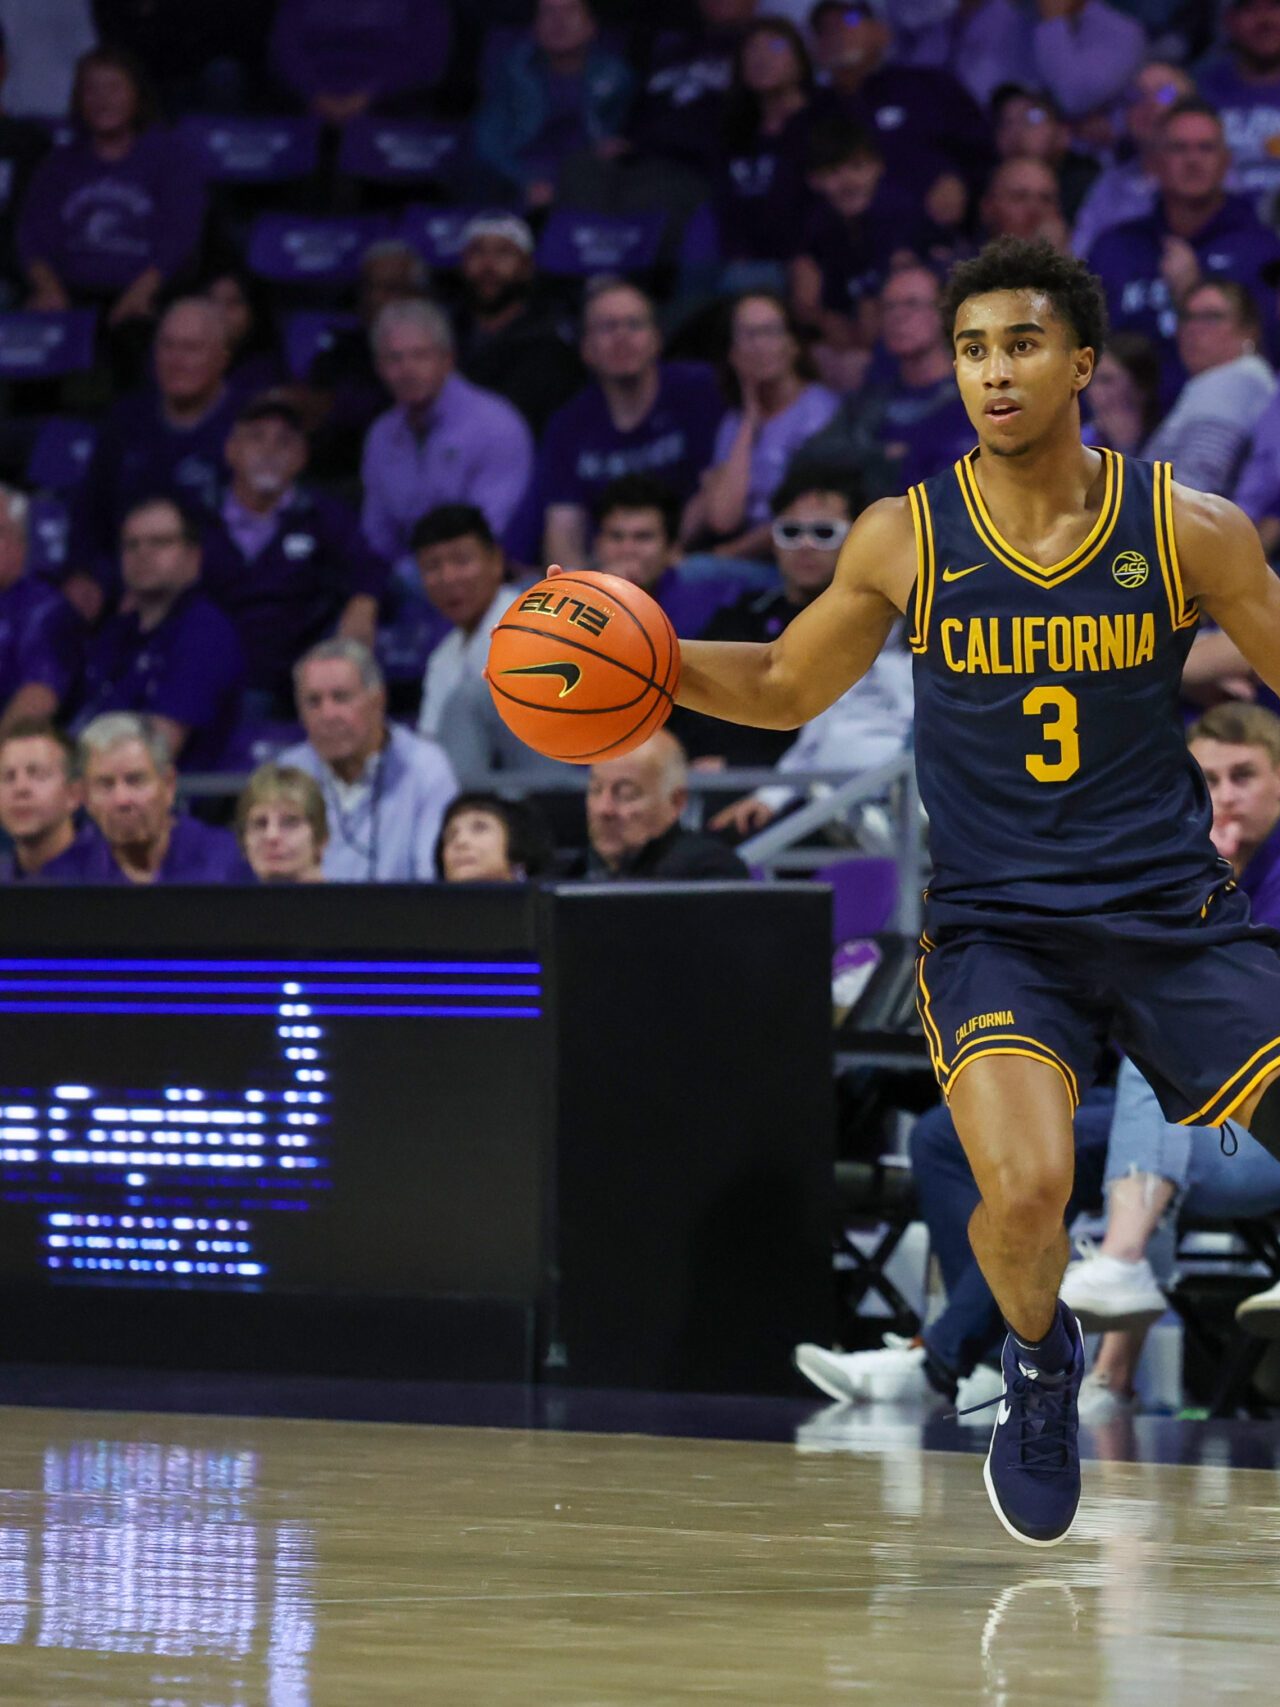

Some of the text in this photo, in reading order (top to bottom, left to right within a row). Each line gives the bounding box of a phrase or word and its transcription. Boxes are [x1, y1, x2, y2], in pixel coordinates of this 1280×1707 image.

[1116, 561, 1148, 574] ACC
[518, 592, 611, 637] ELITE
[940, 612, 1155, 675] CALIFORNIA
[1022, 685, 1080, 783] 3
[955, 1010, 1015, 1045] CALIFORNIA
